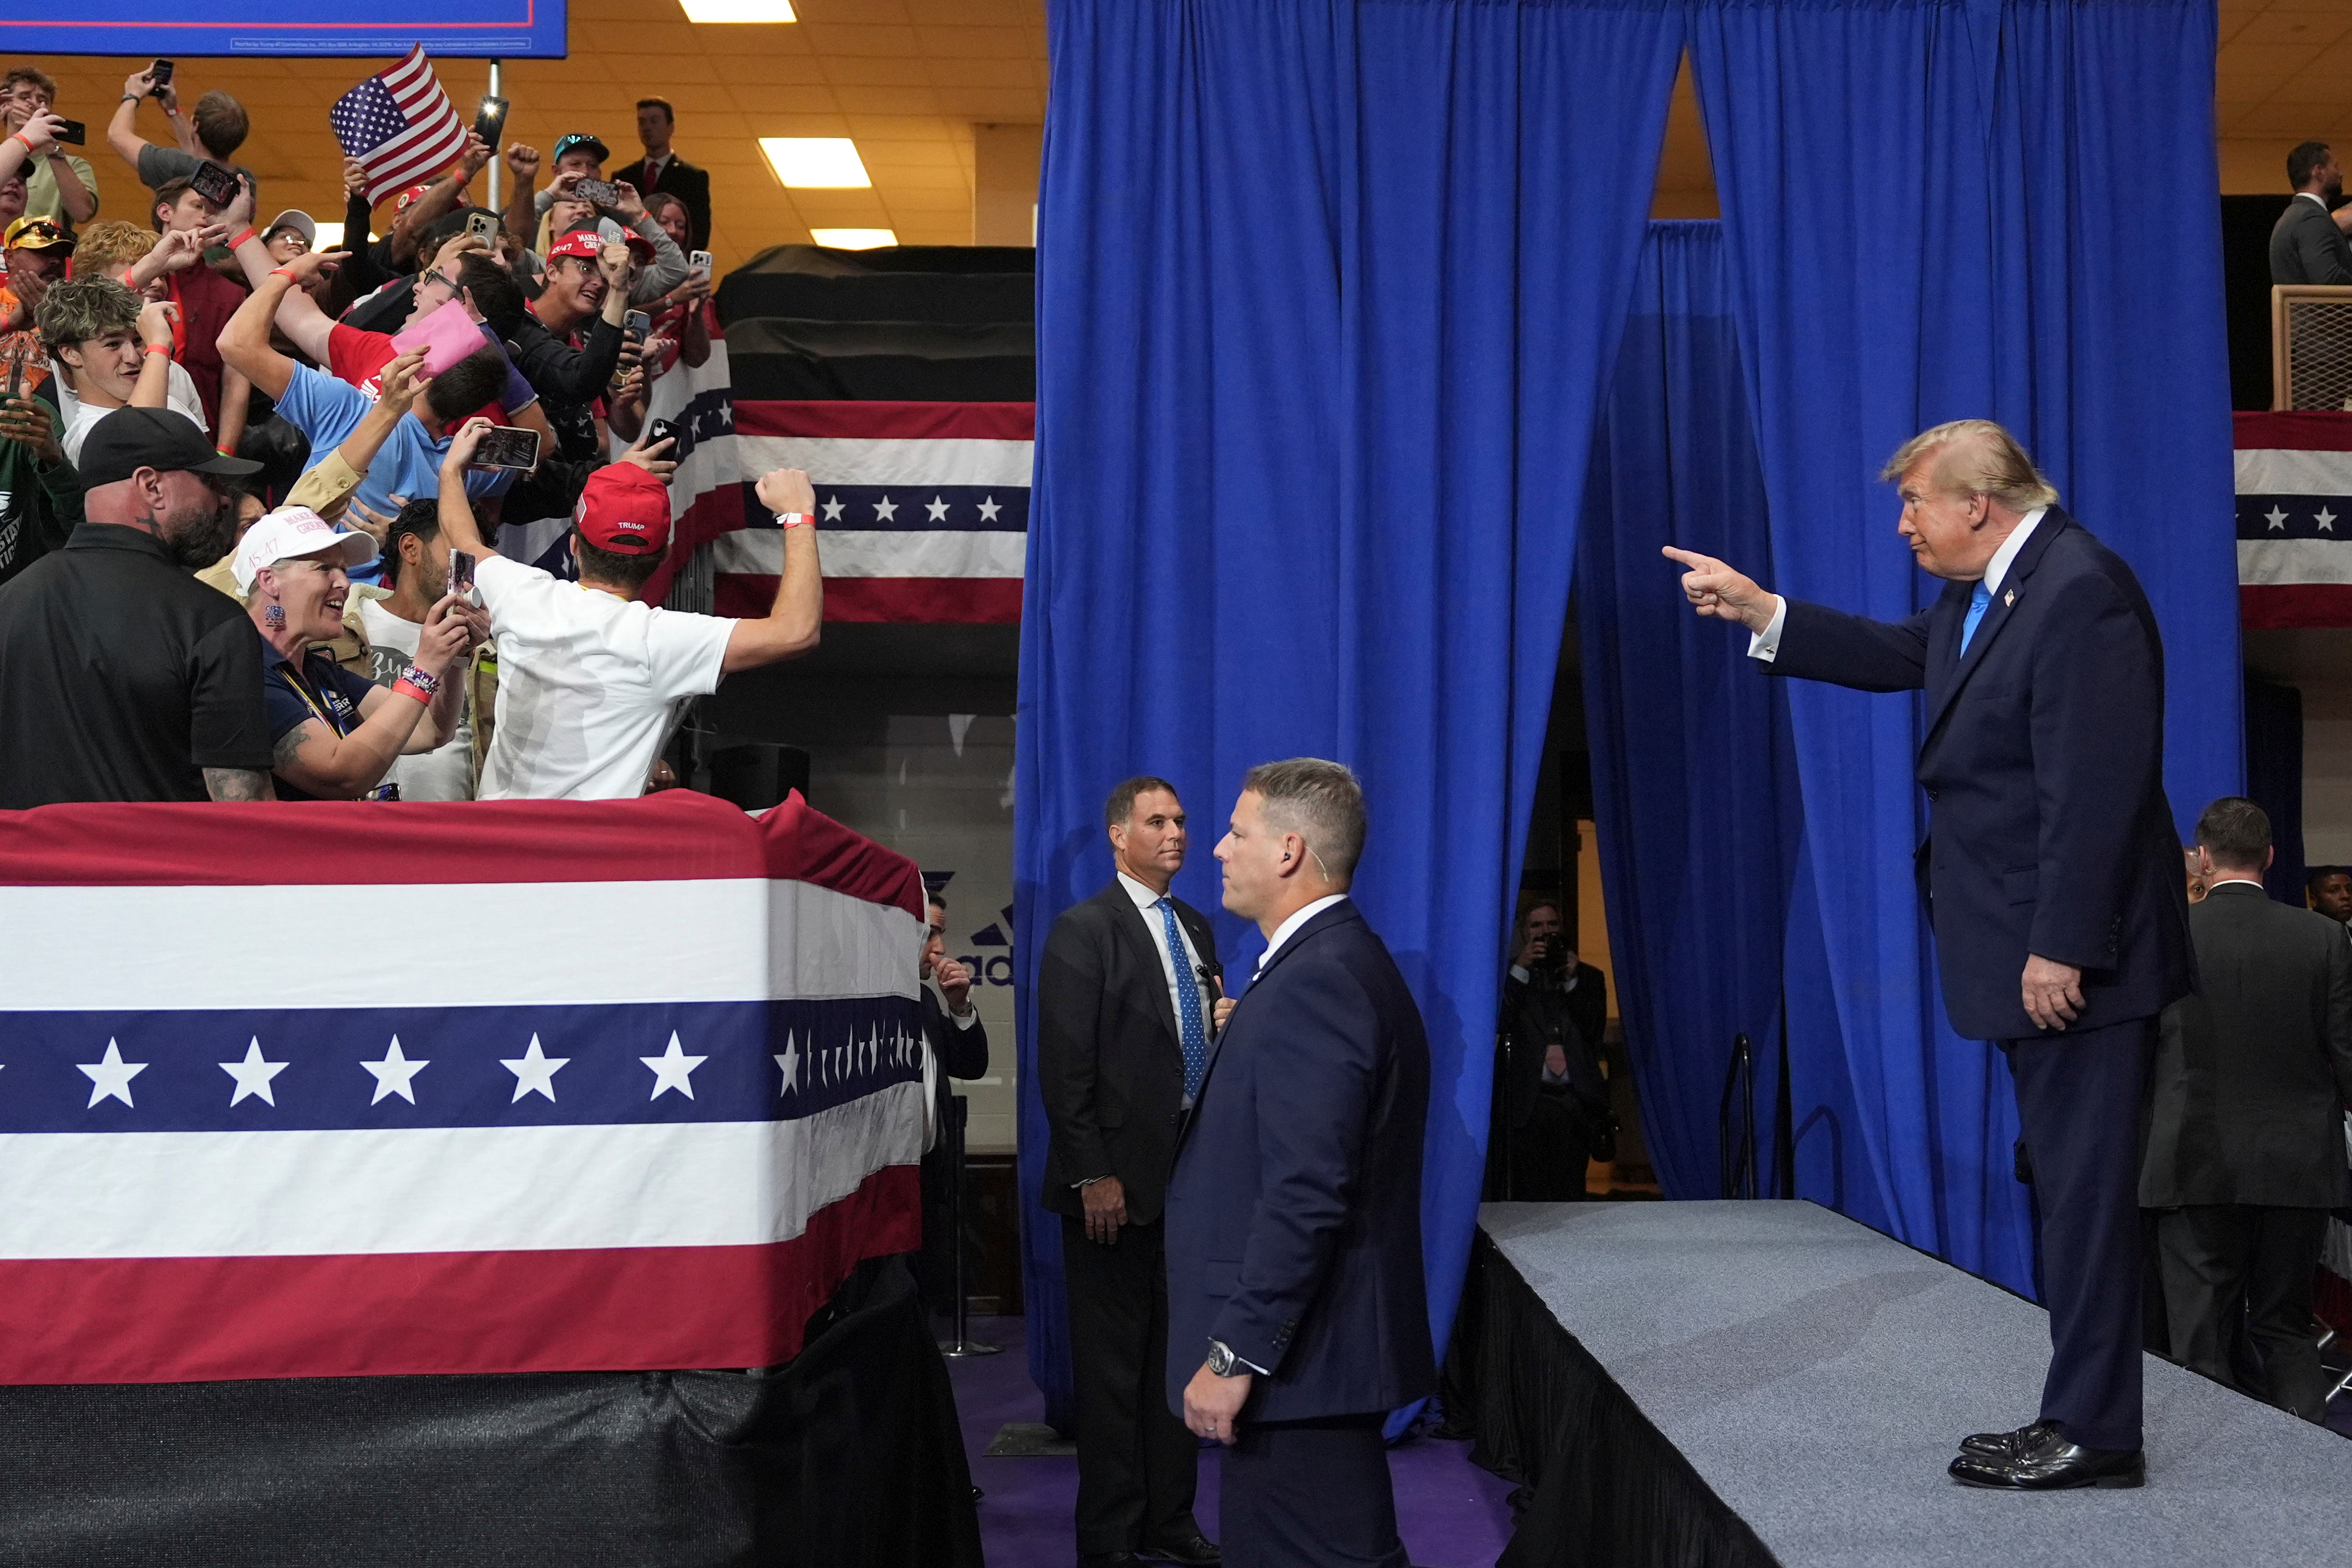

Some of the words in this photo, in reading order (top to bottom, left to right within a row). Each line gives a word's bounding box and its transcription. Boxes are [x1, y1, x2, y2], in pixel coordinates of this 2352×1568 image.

[283, 512, 313, 525] MAKE
[618, 522, 645, 530] TRUMP
[249, 538, 278, 569] 45-47
